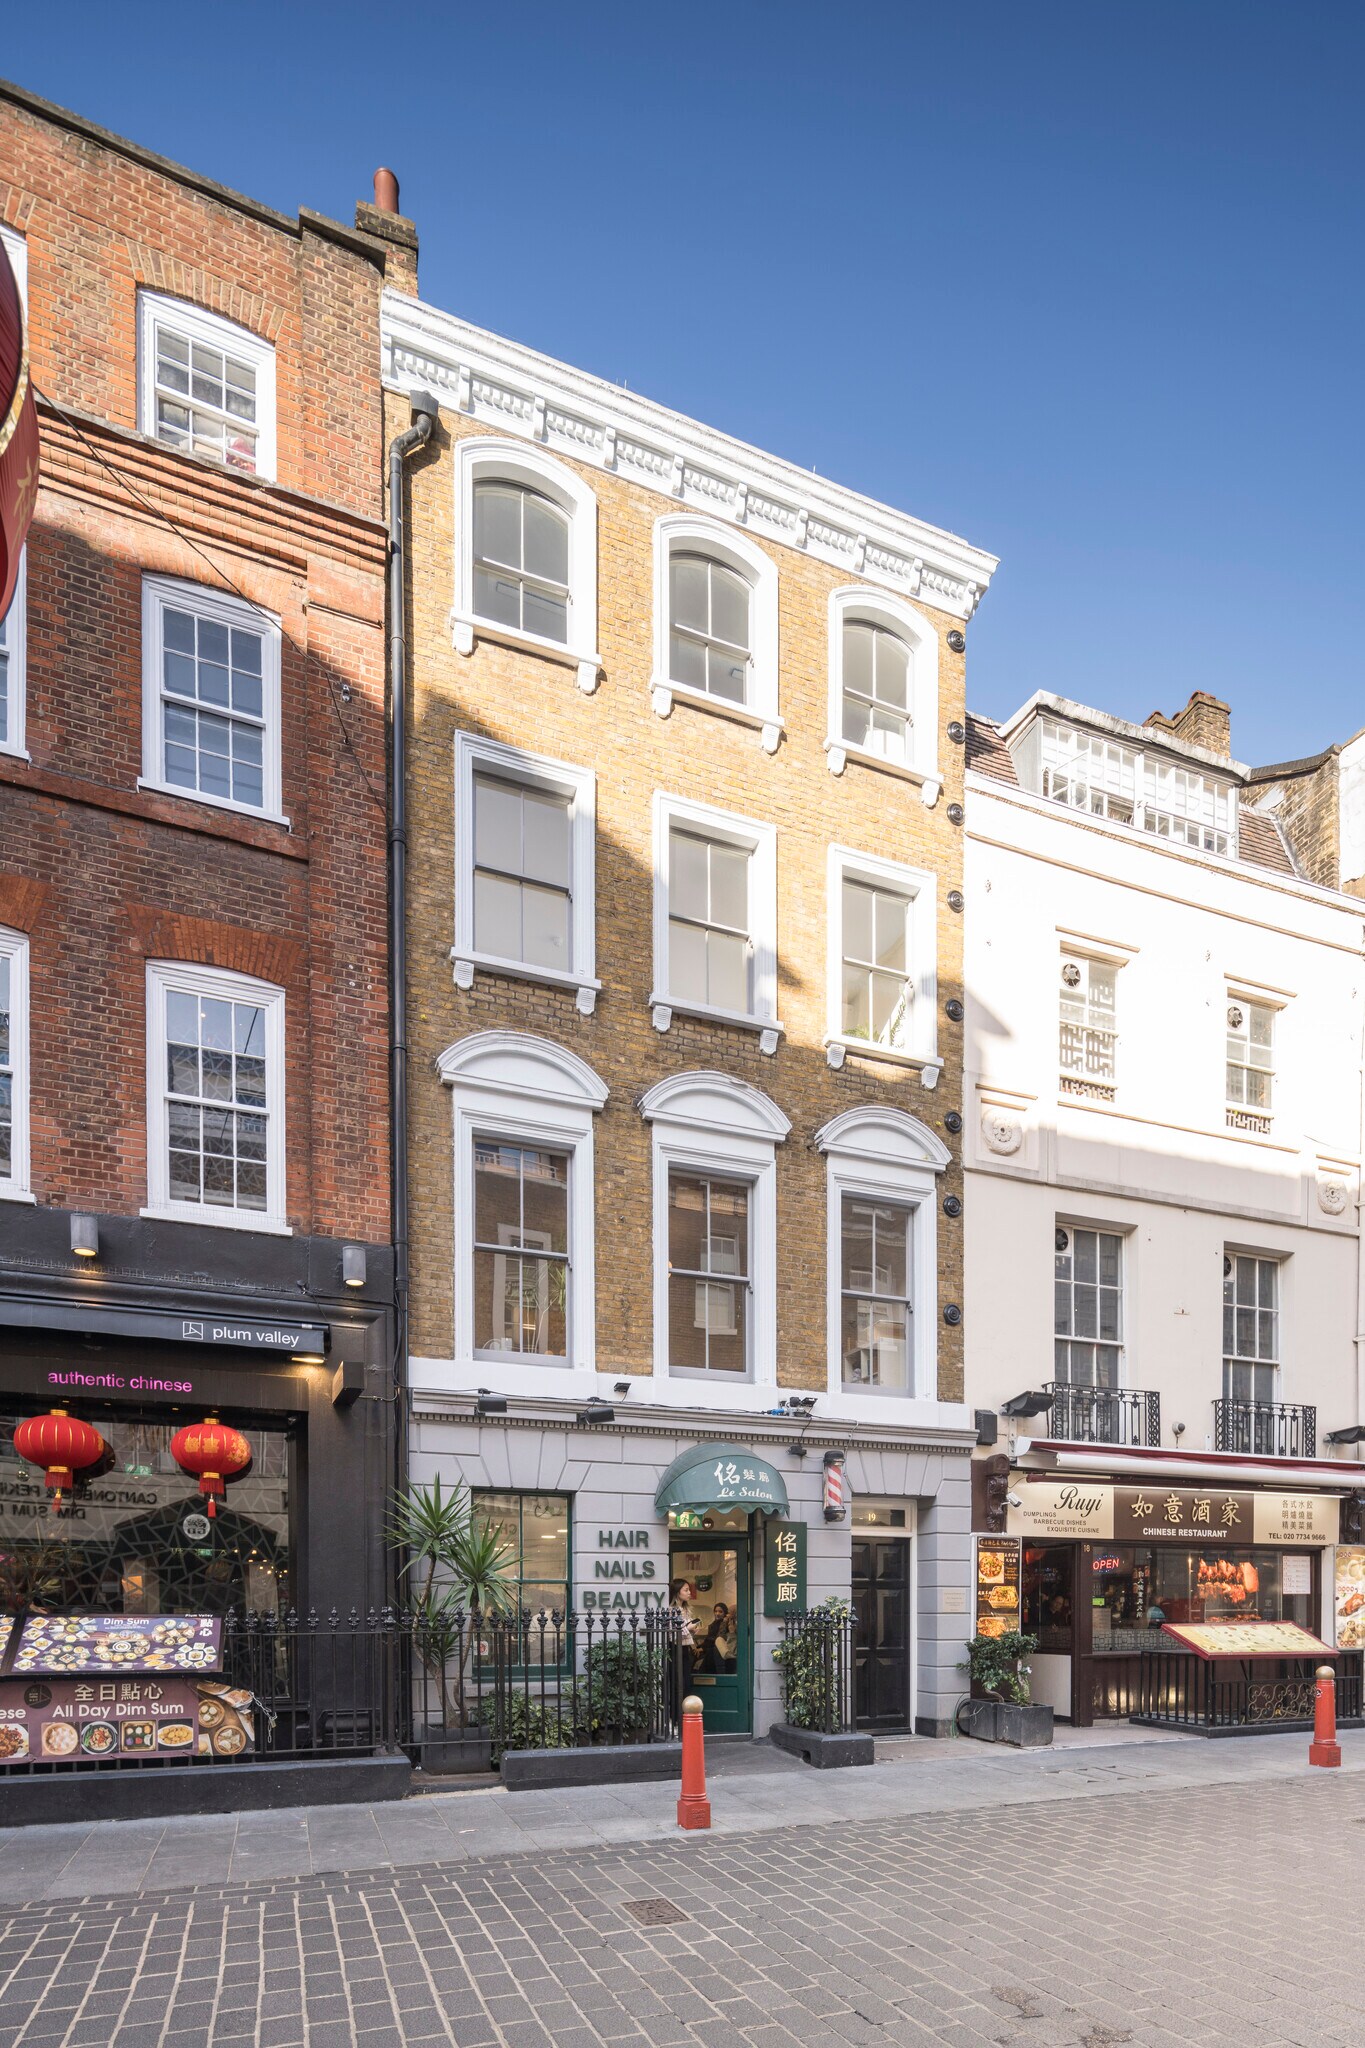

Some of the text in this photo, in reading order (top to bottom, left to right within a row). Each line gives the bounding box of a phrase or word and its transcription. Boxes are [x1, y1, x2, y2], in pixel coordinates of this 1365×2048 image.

[213, 1326, 299, 1347] plum valley
[48, 1371, 192, 1393] authentic chinese
[717, 1486, 773, 1501] Le Salon
[1054, 1486, 1104, 1517] Ruyi
[868, 1513, 876, 1521] 19
[1131, 1493, 1241, 1526] 如意酒家
[599, 1530, 649, 1548] HAIR
[1143, 1528, 1227, 1538] CHINESE RESTAURANT
[595, 1560, 655, 1579] NAILS
[1092, 1558, 1120, 1571] OPEN
[583, 1591, 666, 1610] BEAUTY
[200, 1618, 214, 1637] 點心
[75, 1682, 163, 1702] 全日點心
[0, 1708, 26, 1719] ese
[52, 1702, 184, 1721] All Day Dim Sum
